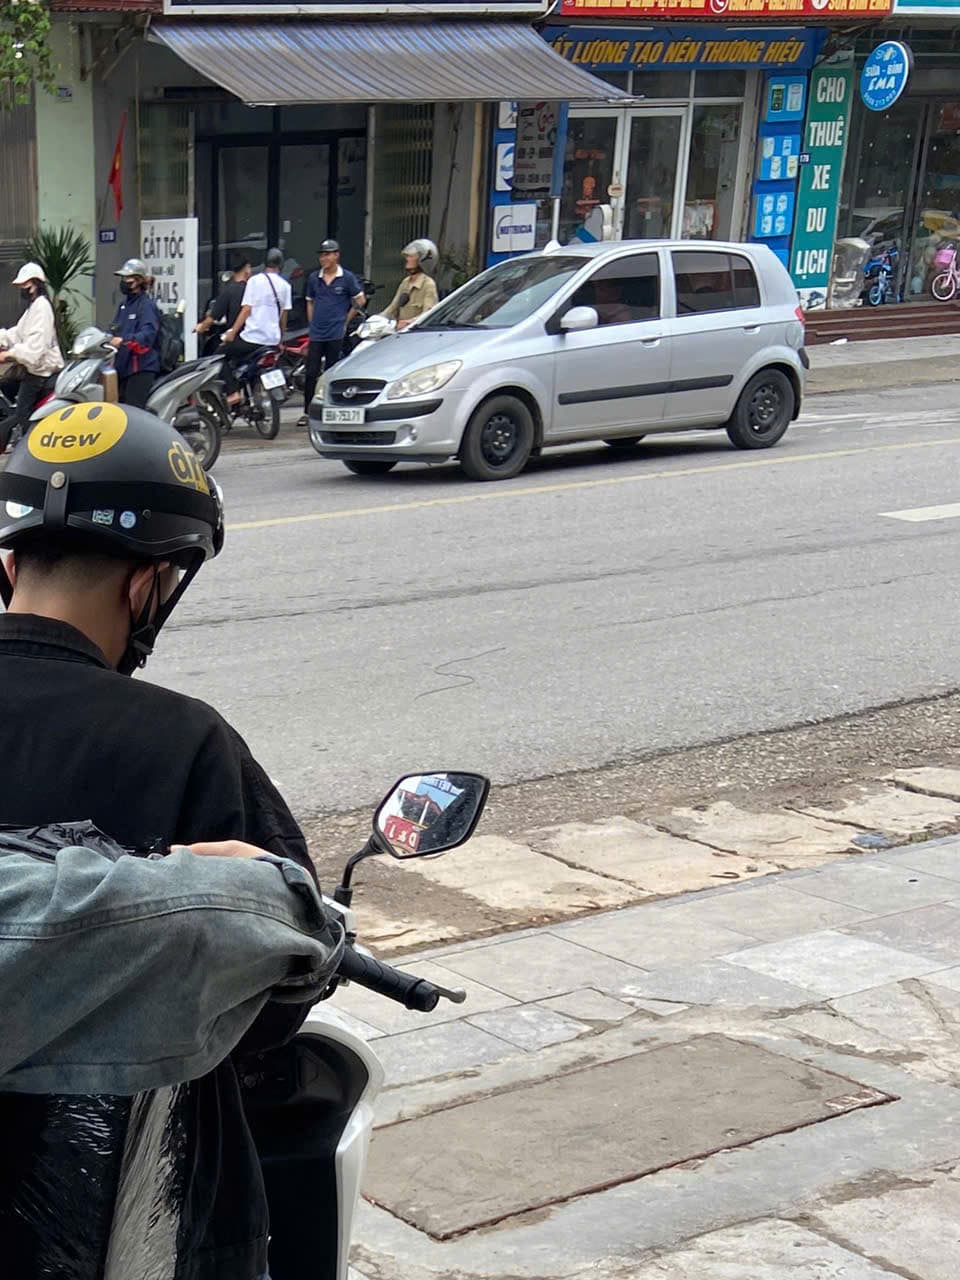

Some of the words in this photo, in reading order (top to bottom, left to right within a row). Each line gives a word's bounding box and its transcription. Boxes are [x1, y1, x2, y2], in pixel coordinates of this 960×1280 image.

[572, 39, 629, 68] LƯỢNG
[629, 41, 662, 68] TẠO
[662, 36, 702, 64] NÊN
[699, 39, 765, 64] THƯƠNG
[763, 37, 805, 67] HIỆU
[816, 76, 846, 103] CHO
[809, 116, 844, 147] THUÊ
[811, 164, 831, 191] XE
[805, 208, 827, 233] DU
[143, 225, 161, 259] CẮT
[163, 230, 185, 259] TÓC
[795, 250, 828, 279] LỊCH
[40, 431, 102, 449] drew
